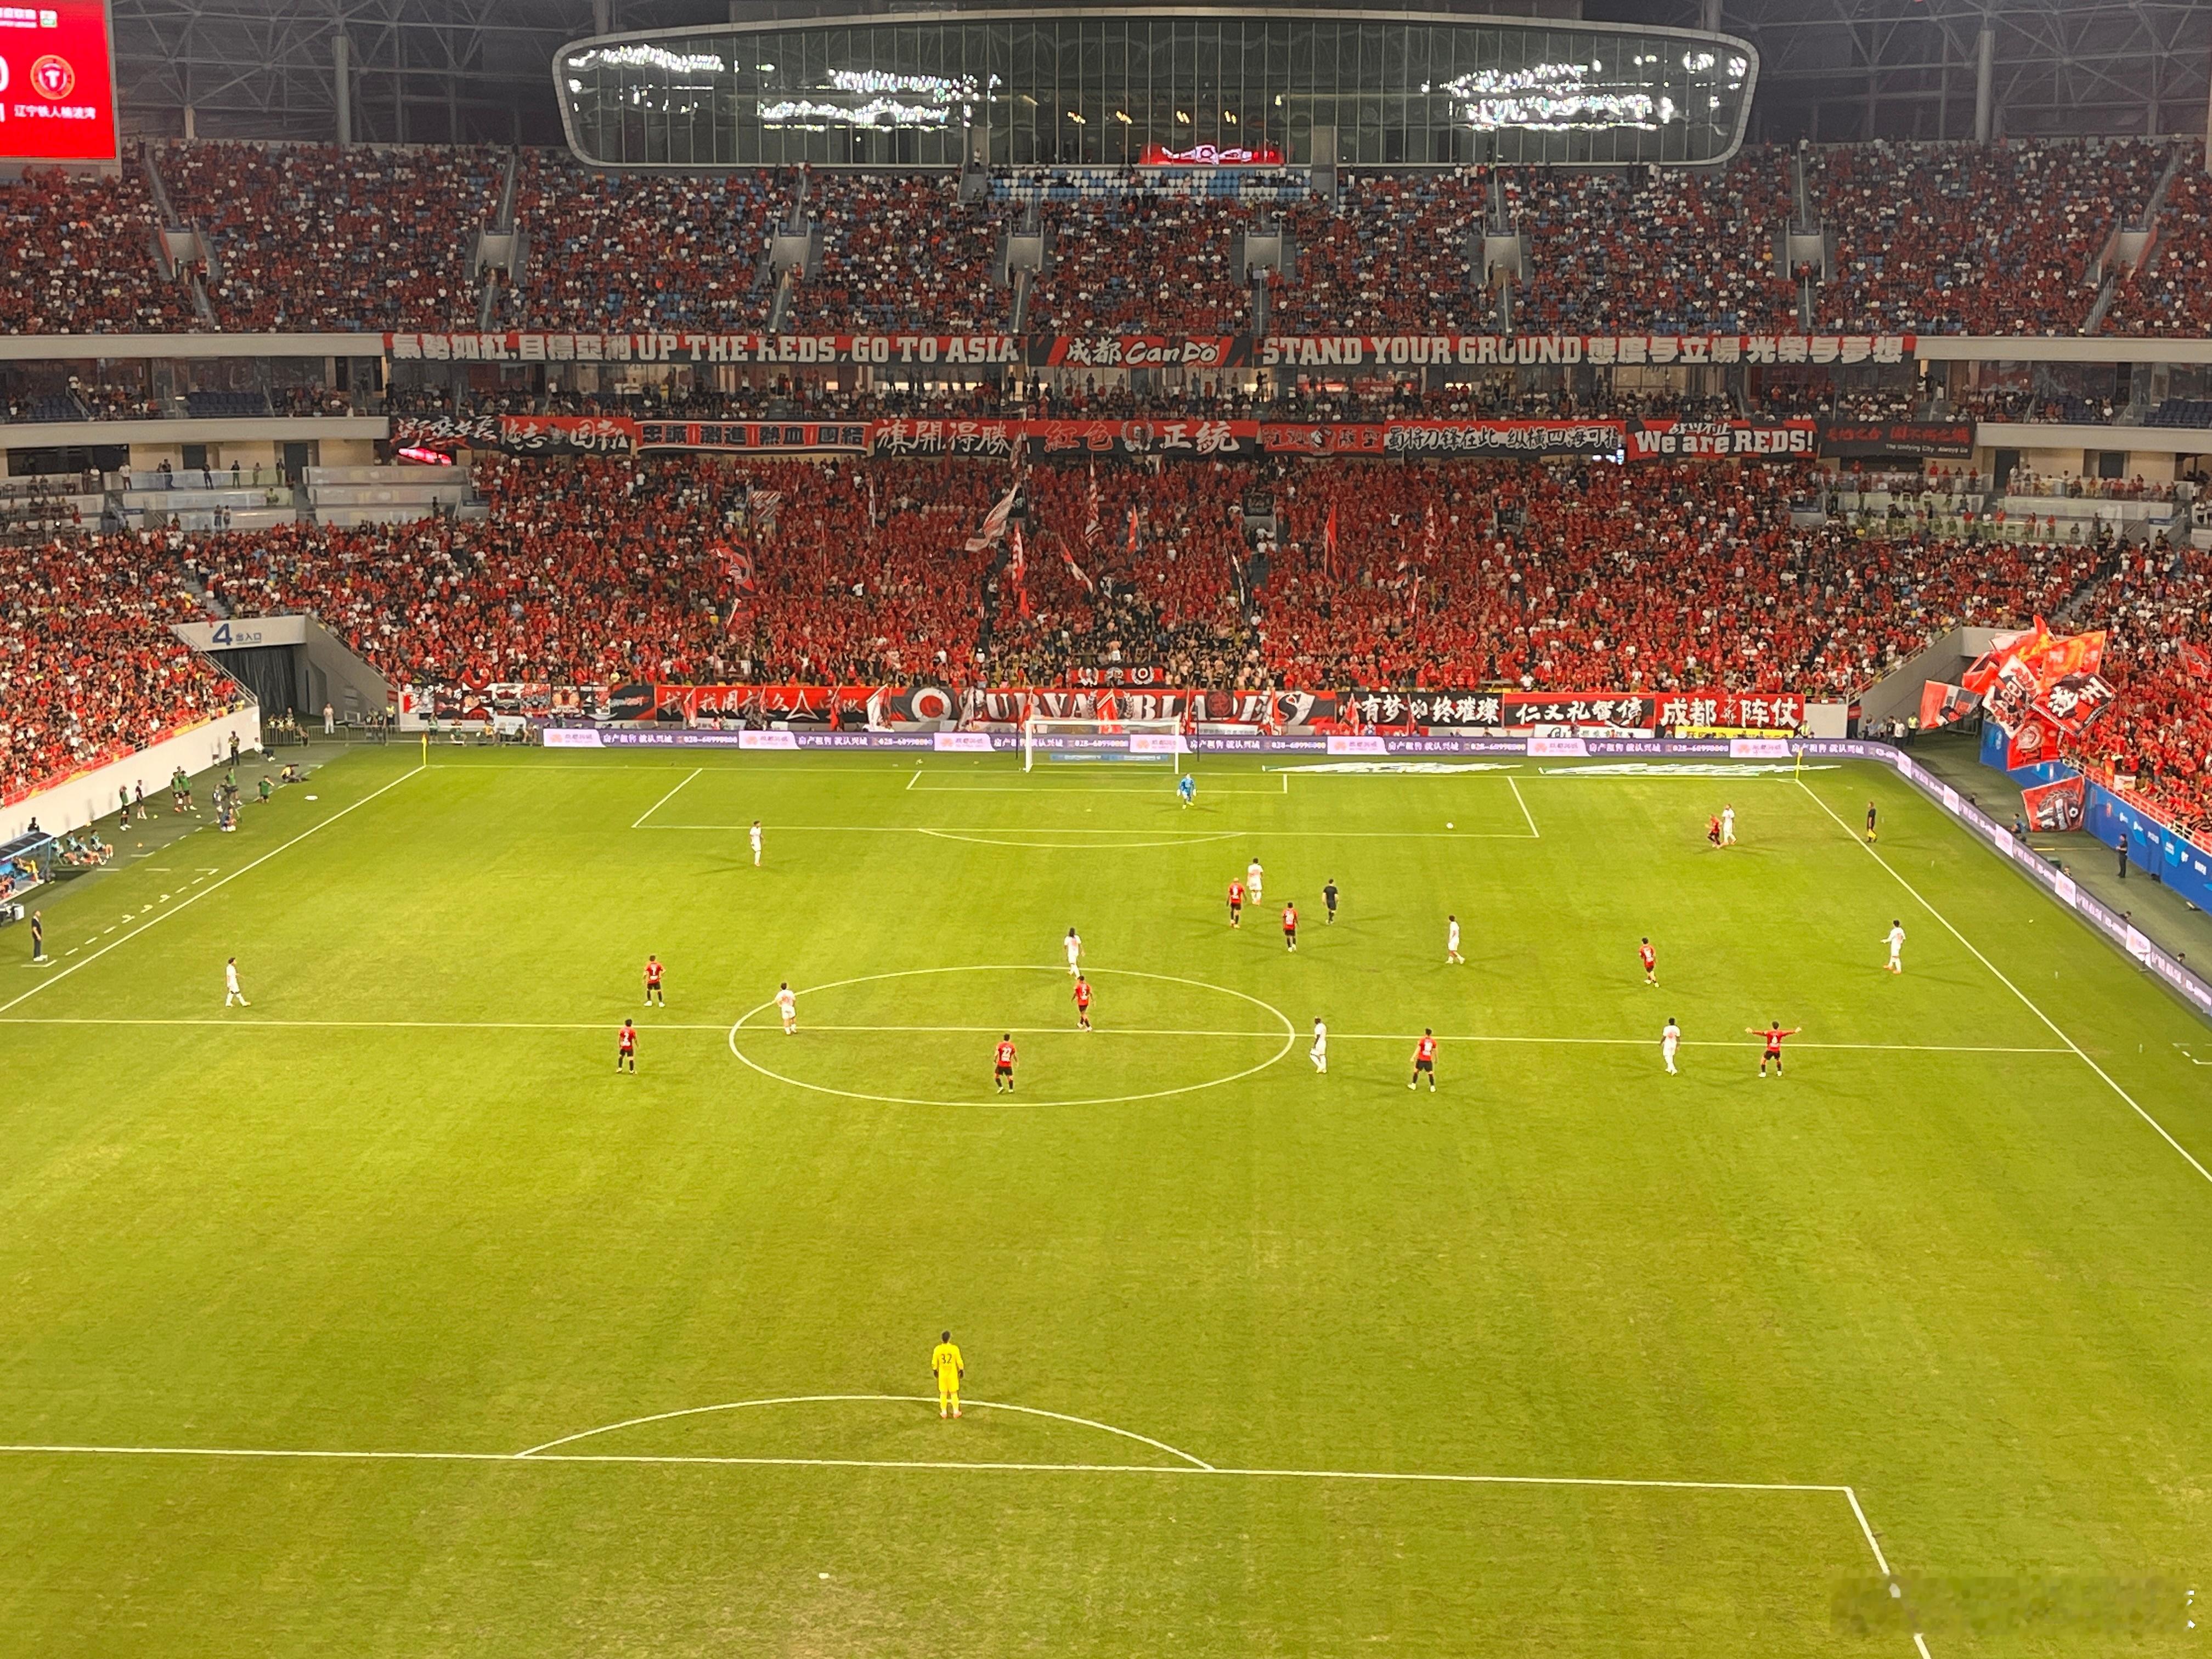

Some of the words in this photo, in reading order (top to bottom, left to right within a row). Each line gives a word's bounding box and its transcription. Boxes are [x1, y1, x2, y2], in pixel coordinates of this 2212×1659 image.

[637, 335, 678, 360] UP
[685, 336, 749, 362] THE
[851, 336, 889, 362] GO
[896, 336, 938, 363] TO
[945, 336, 1019, 363] ASIA
[1066, 337, 1122, 366] 成都
[1262, 336, 1363, 365] STAND
[1371, 336, 1452, 364] YOUR
[1458, 336, 1582, 364] GROUND
[877, 419, 1012, 456] 旗開得勝
[1635, 430, 1676, 453] We
[1682, 436, 1730, 454] are
[1734, 430, 1813, 453] REDS!
[212, 623, 233, 646] 4
[235, 633, 262, 642] 出入口
[1515, 696, 1643, 725] 仁义礼智信
[1659, 697, 1717, 728] 成都
[1739, 697, 1801, 729] 阵仗
[941, 1353, 952, 1364] 32
